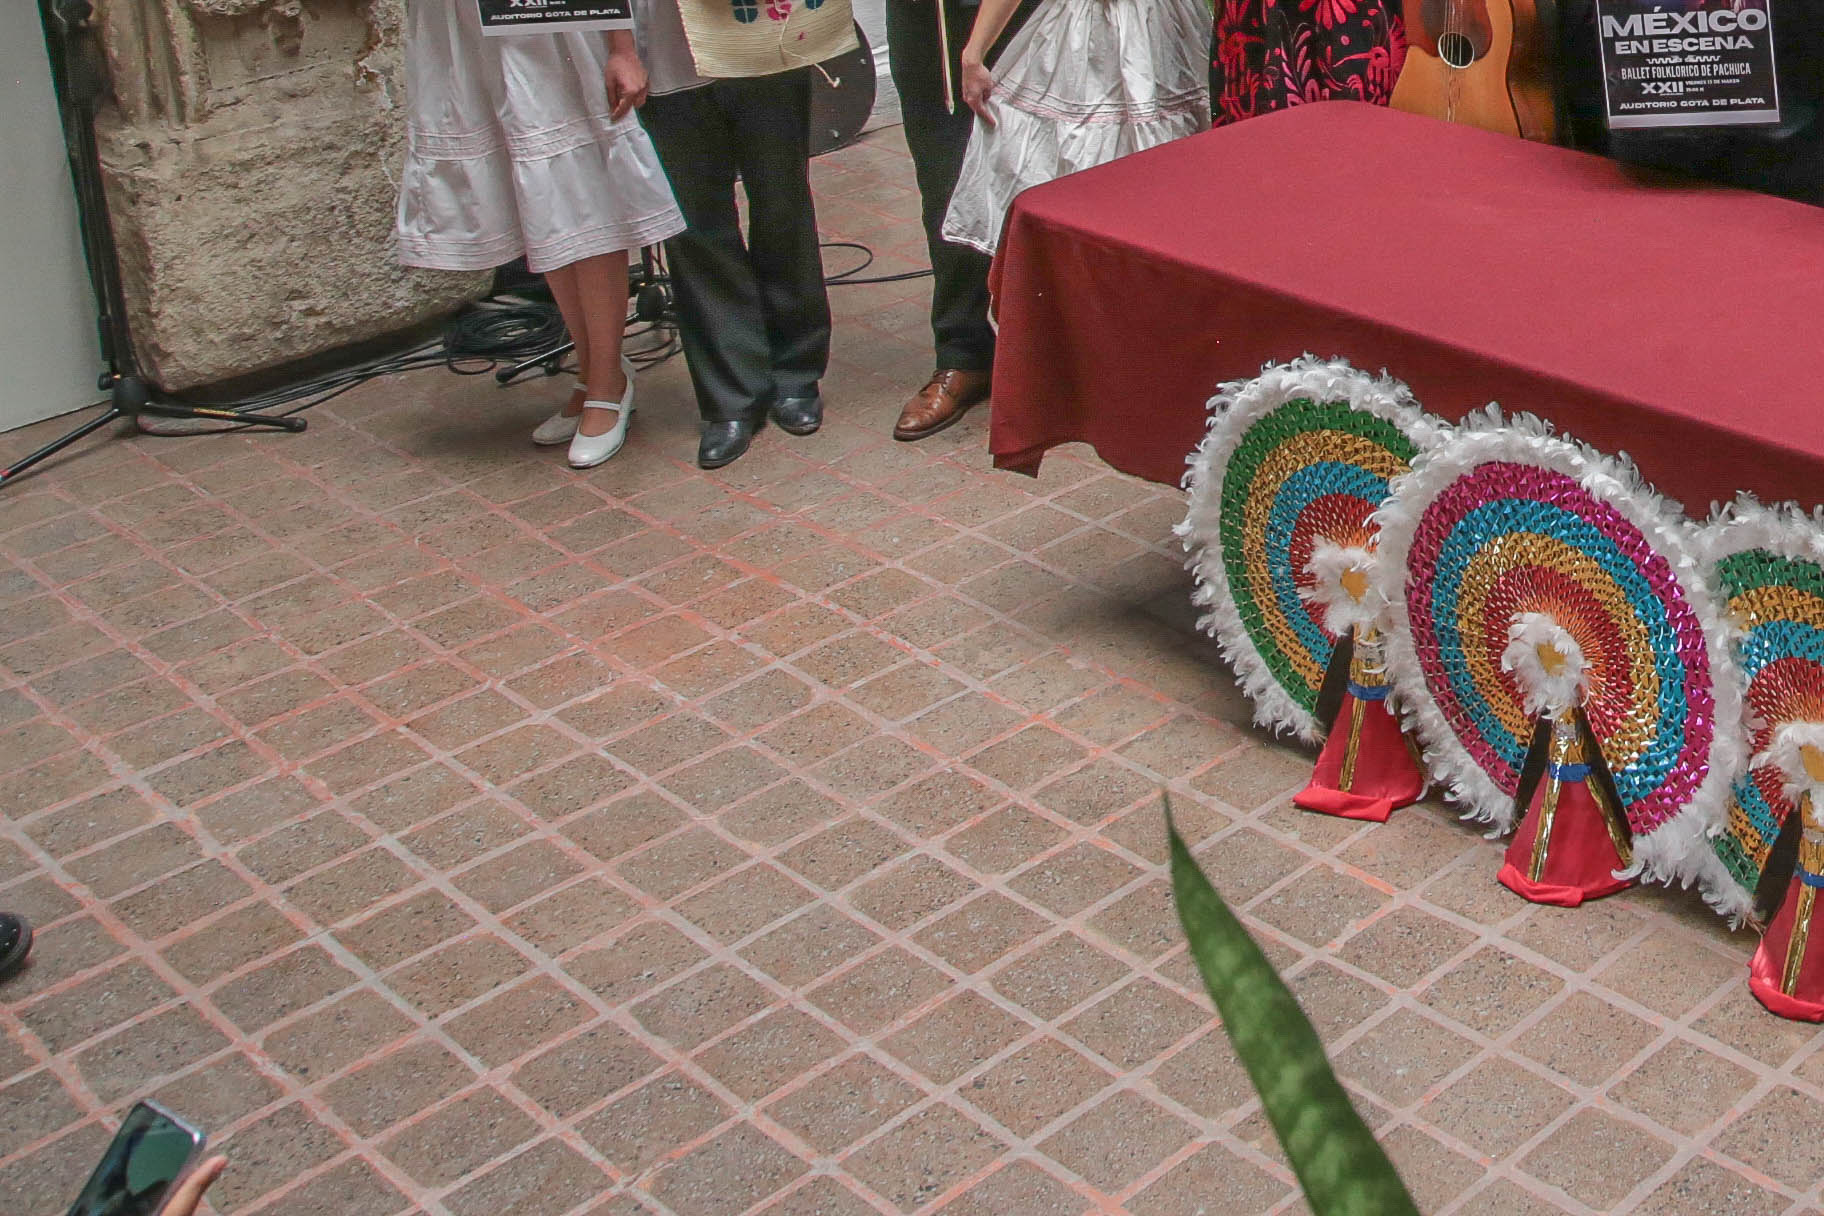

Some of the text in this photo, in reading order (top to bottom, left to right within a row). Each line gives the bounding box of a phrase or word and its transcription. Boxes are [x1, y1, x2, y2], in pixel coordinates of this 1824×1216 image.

[490, 12, 543, 21] AUDITORIO
[1601, 6, 1767, 38] MÉXICO
[1615, 35, 1755, 55] EN ESCENA
[1621, 62, 1752, 80] BALLET FOLKLORICO DE PACHUCA
[1641, 81, 1684, 95] XXII
[1619, 97, 1766, 110] AUDITORIO GOTA DE PLATA
